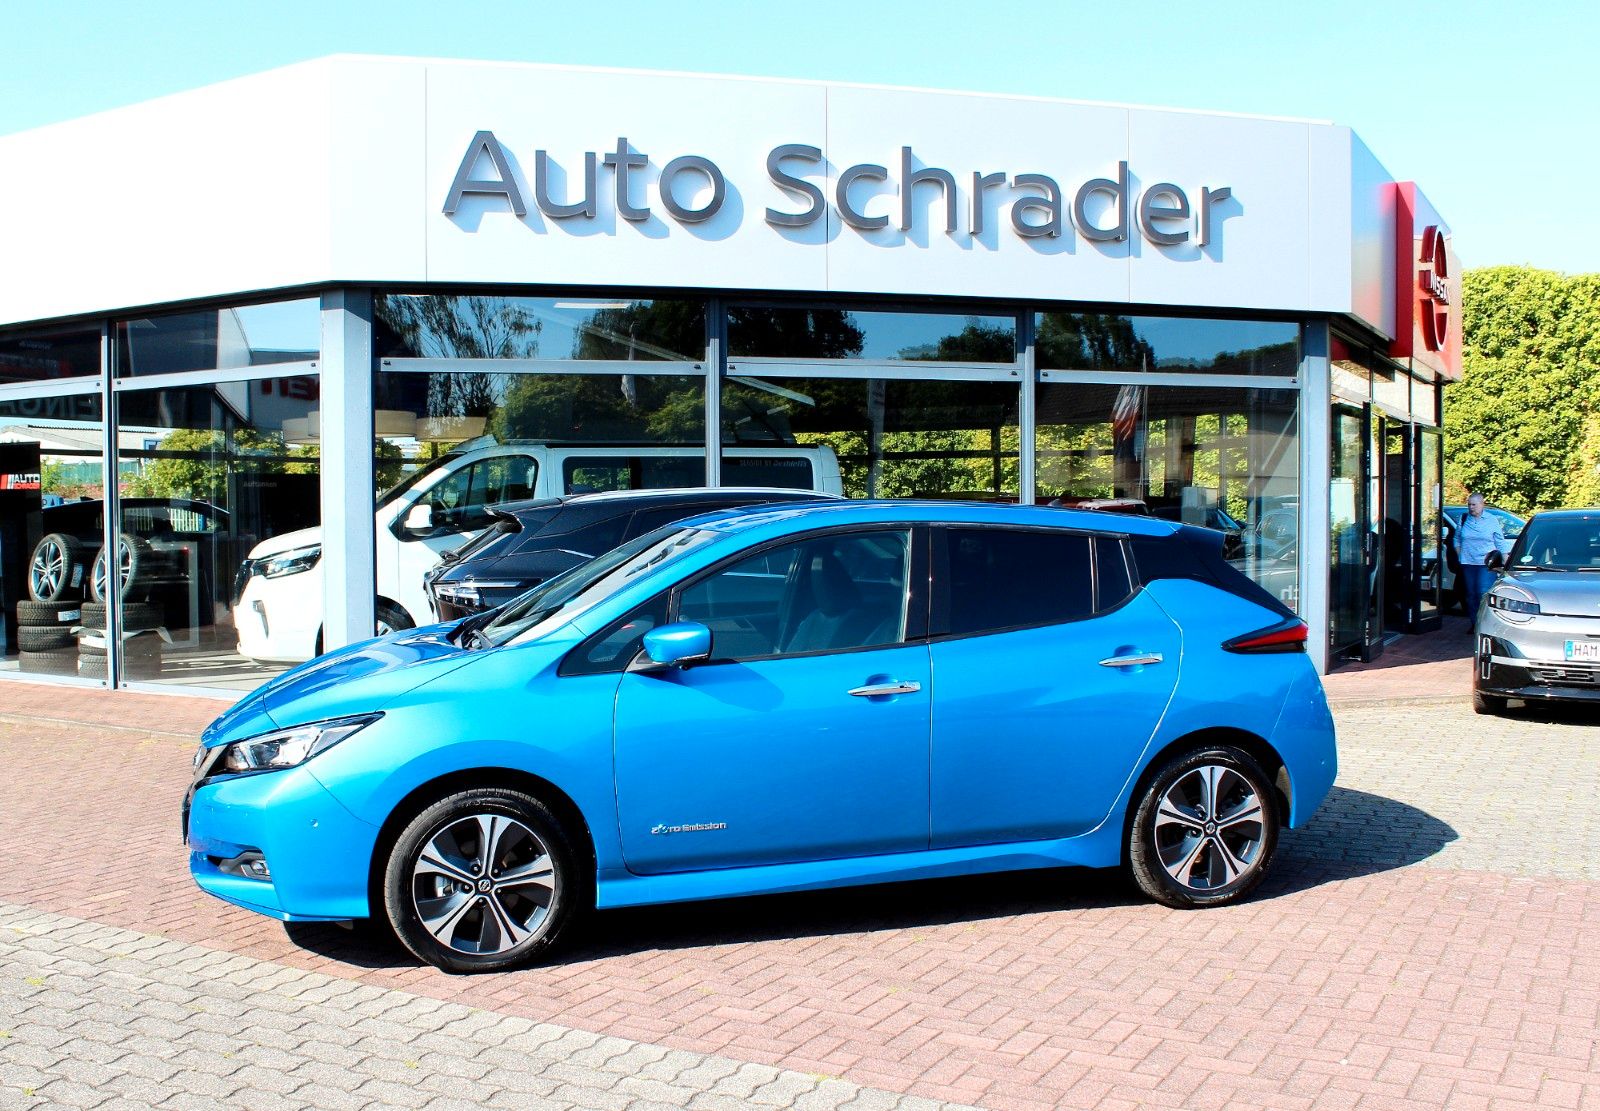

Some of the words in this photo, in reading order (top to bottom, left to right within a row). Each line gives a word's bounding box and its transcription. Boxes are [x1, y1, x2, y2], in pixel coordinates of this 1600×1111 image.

[441, 129, 727, 223] Auto
[764, 143, 1233, 248] Schrader
[14, 474, 40, 483] AUTO
[1574, 644, 1598, 656] HAM
[682, 822, 727, 833] Emission
